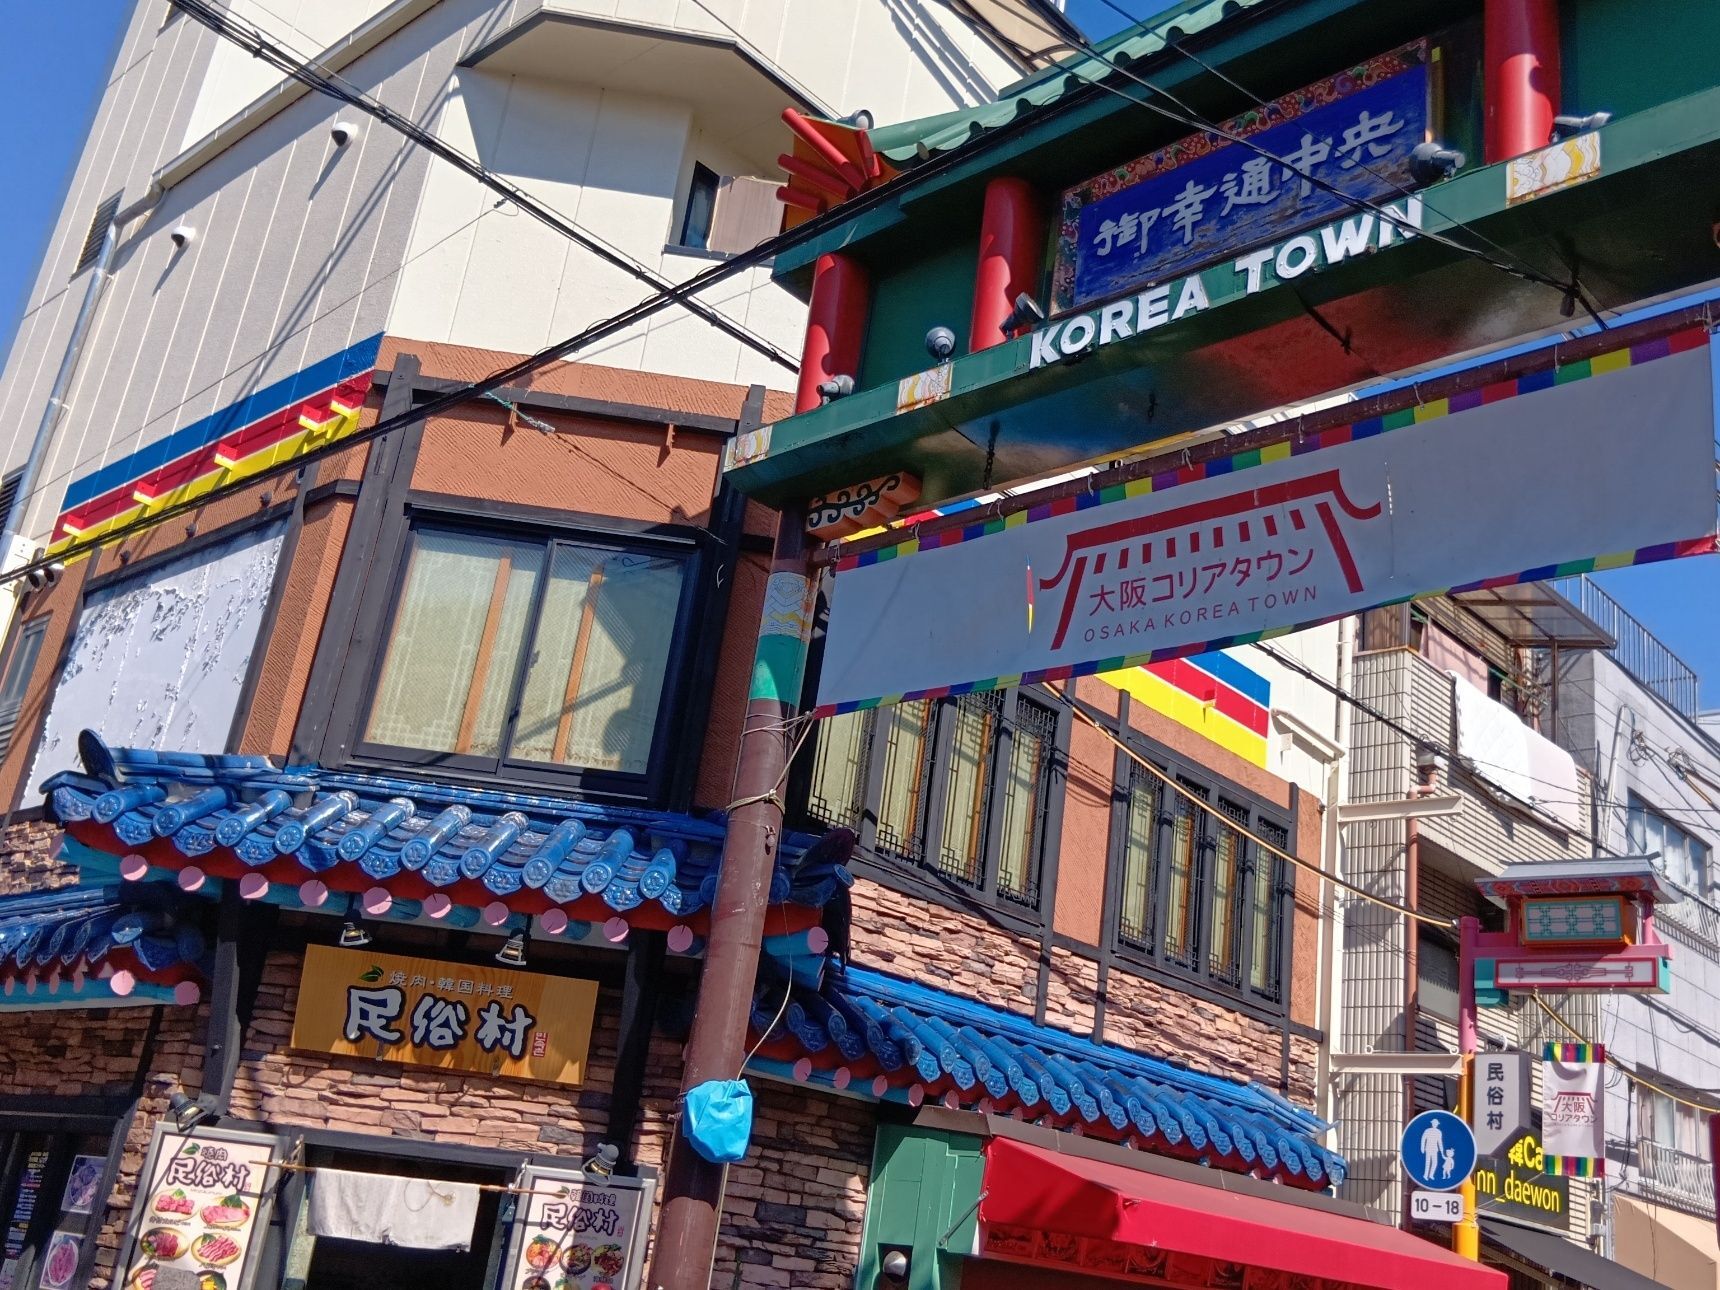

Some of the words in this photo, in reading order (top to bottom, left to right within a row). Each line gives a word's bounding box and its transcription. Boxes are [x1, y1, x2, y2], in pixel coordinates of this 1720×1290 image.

[1029, 279, 1210, 368] KOREA
[1234, 194, 1423, 294] TOWN
[1084, 618, 1155, 642] OSAKA
[1164, 603, 1240, 628] KOREA
[1249, 585, 1318, 612] TOWN
[1089, 549, 1314, 616] 大阪コリアタウン
[344, 986, 535, 1060] 民俗村
[1487, 1063, 1504, 1130] 民俗村
[1561, 1102, 1586, 1113] 大阪
[166, 1157, 250, 1192] 民俗村
[540, 1203, 620, 1236] 民俗村
